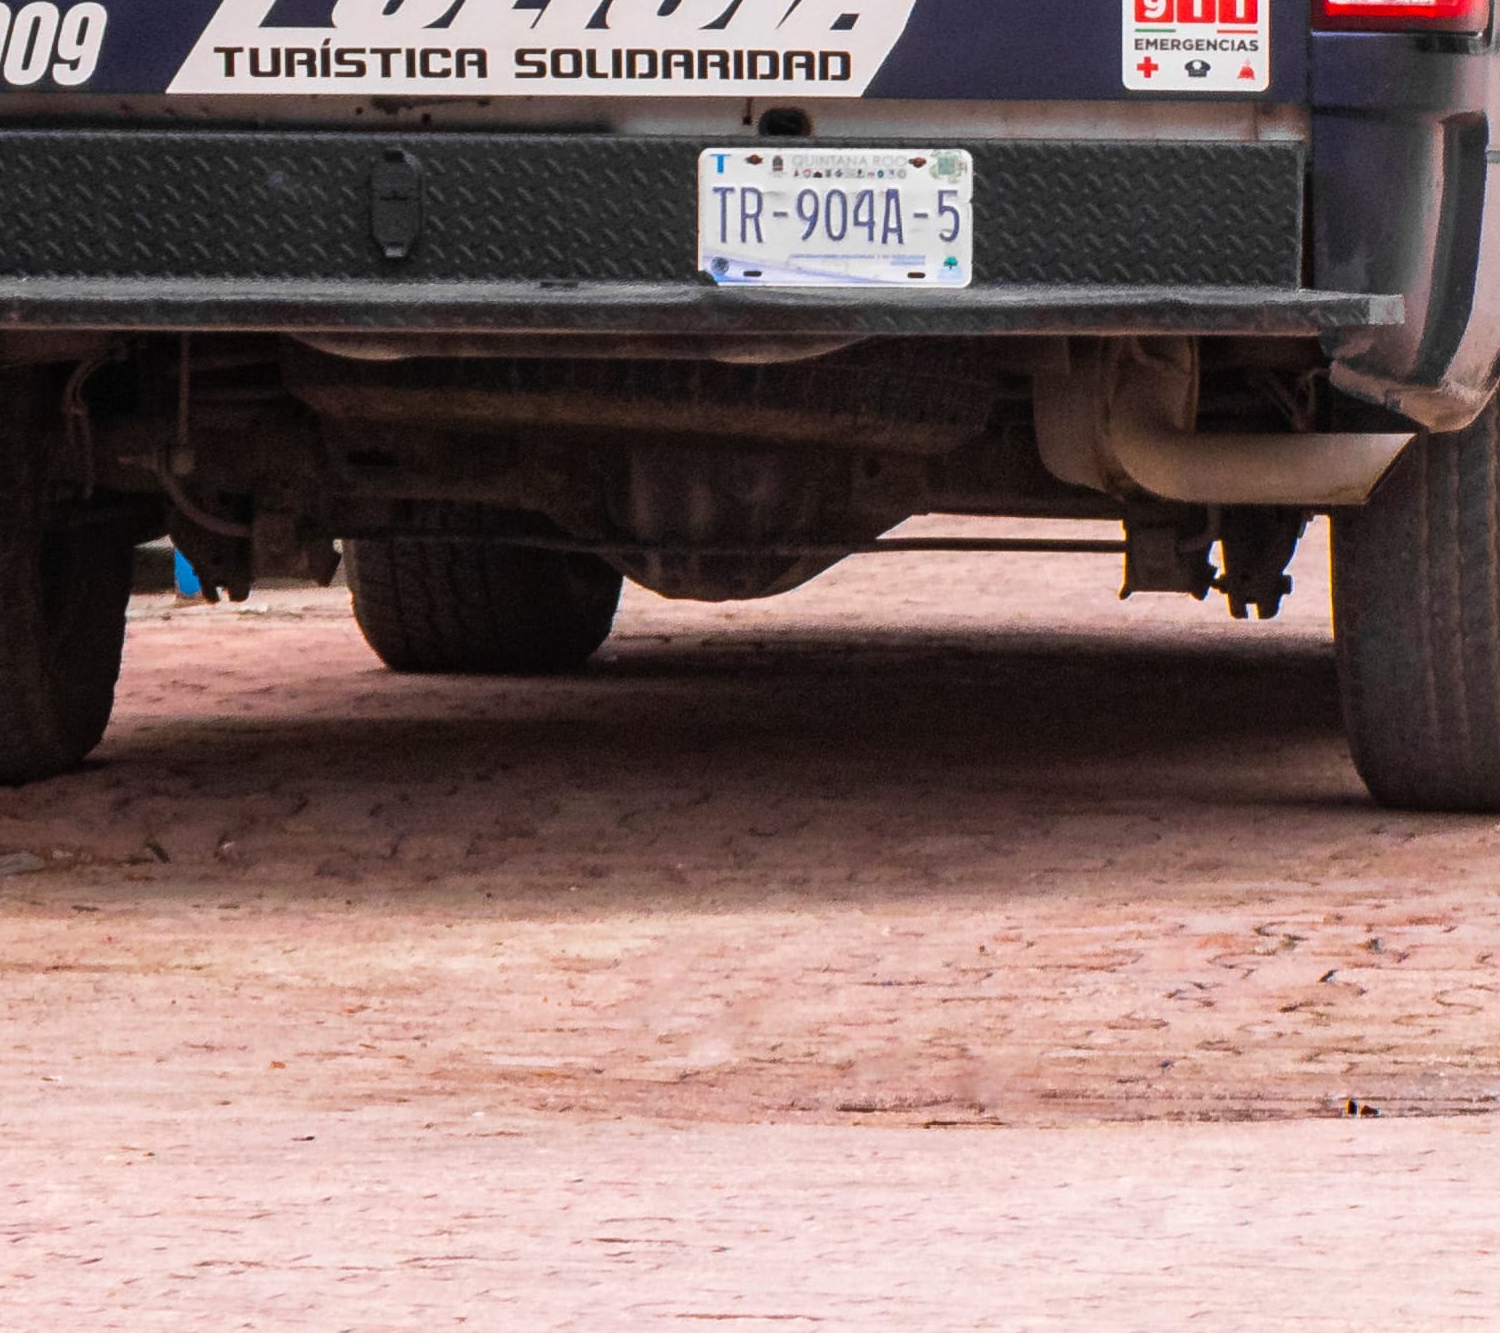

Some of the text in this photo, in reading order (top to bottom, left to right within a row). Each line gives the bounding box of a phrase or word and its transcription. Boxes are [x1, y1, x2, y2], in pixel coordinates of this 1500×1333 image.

[214, 37, 853, 81] TURÍSTICA SOLIDARIDAD
[1134, 38, 1259, 52] EMERGENCIAS
[709, 153, 731, 174] T
[713, 185, 960, 245] TR-904A-5
